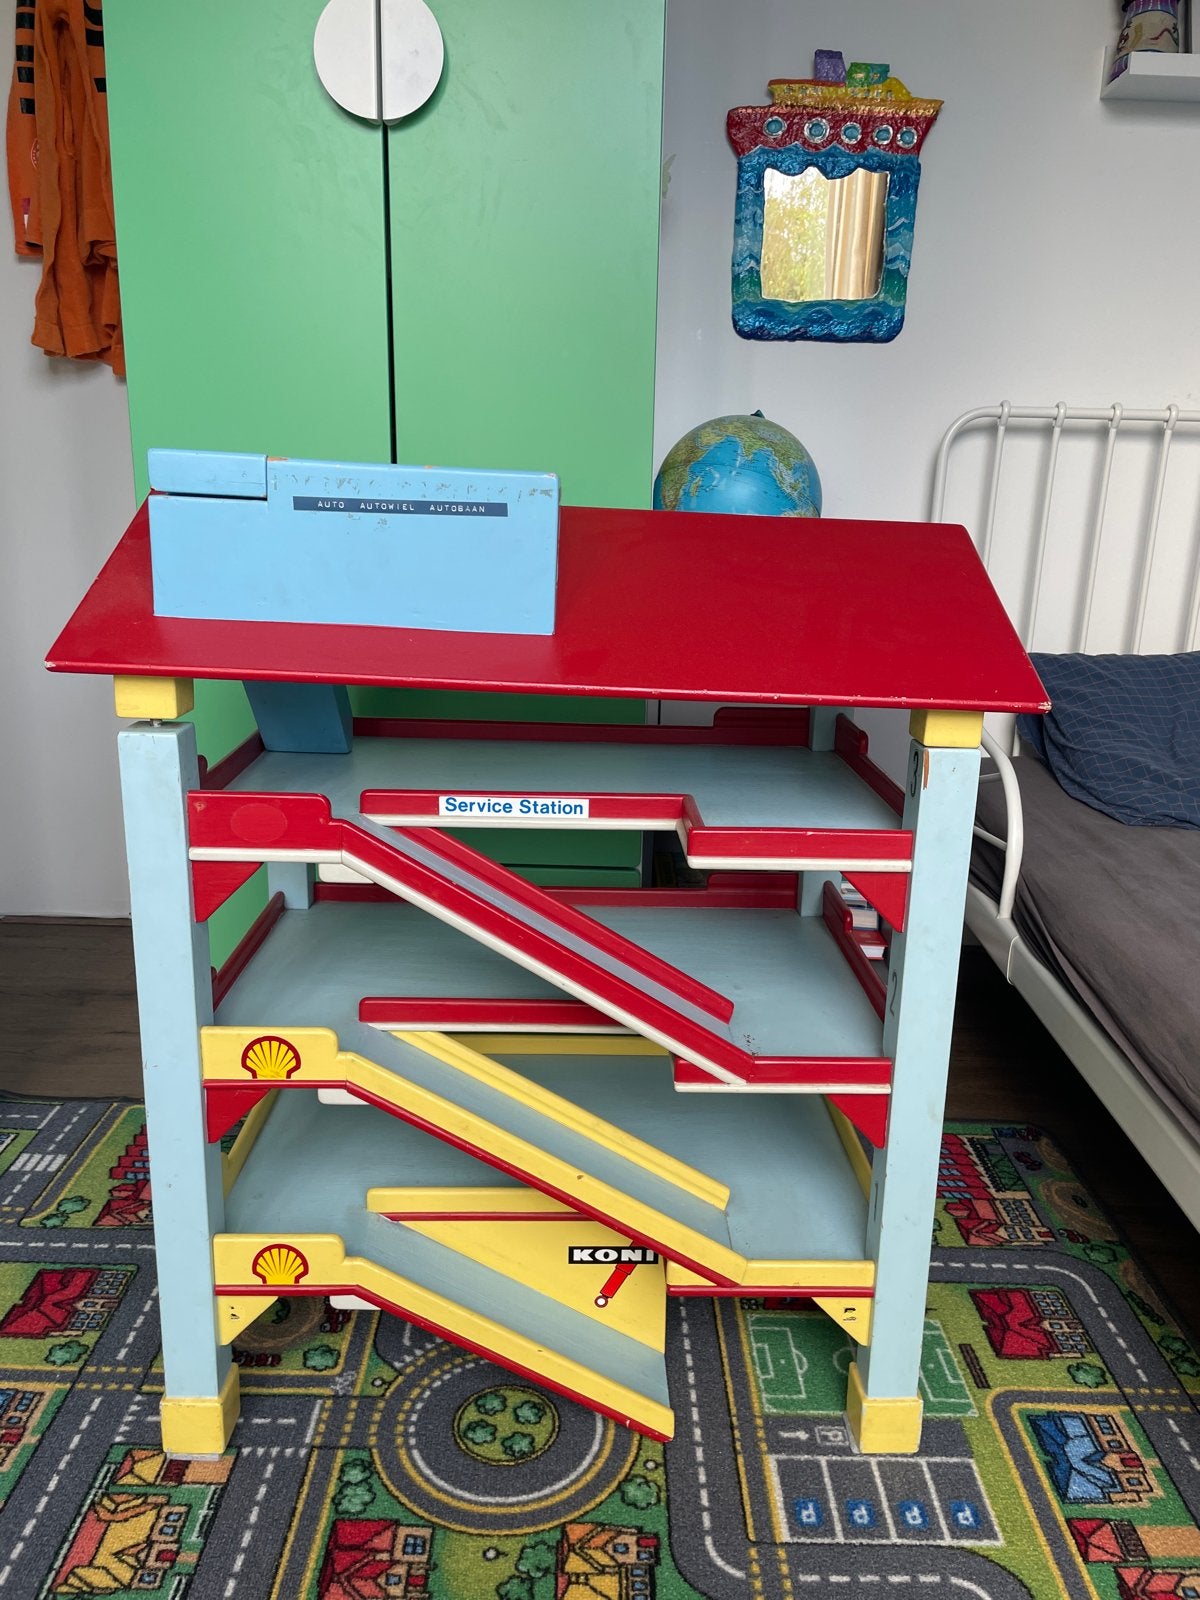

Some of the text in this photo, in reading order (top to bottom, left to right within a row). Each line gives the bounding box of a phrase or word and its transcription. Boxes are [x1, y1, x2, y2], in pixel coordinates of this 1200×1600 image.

[318, 500, 485, 513] AUTO AUTOWIEL AUTOBAAN
[445, 797, 584, 815] Service Station
[573, 1249, 655, 1262] KONI
